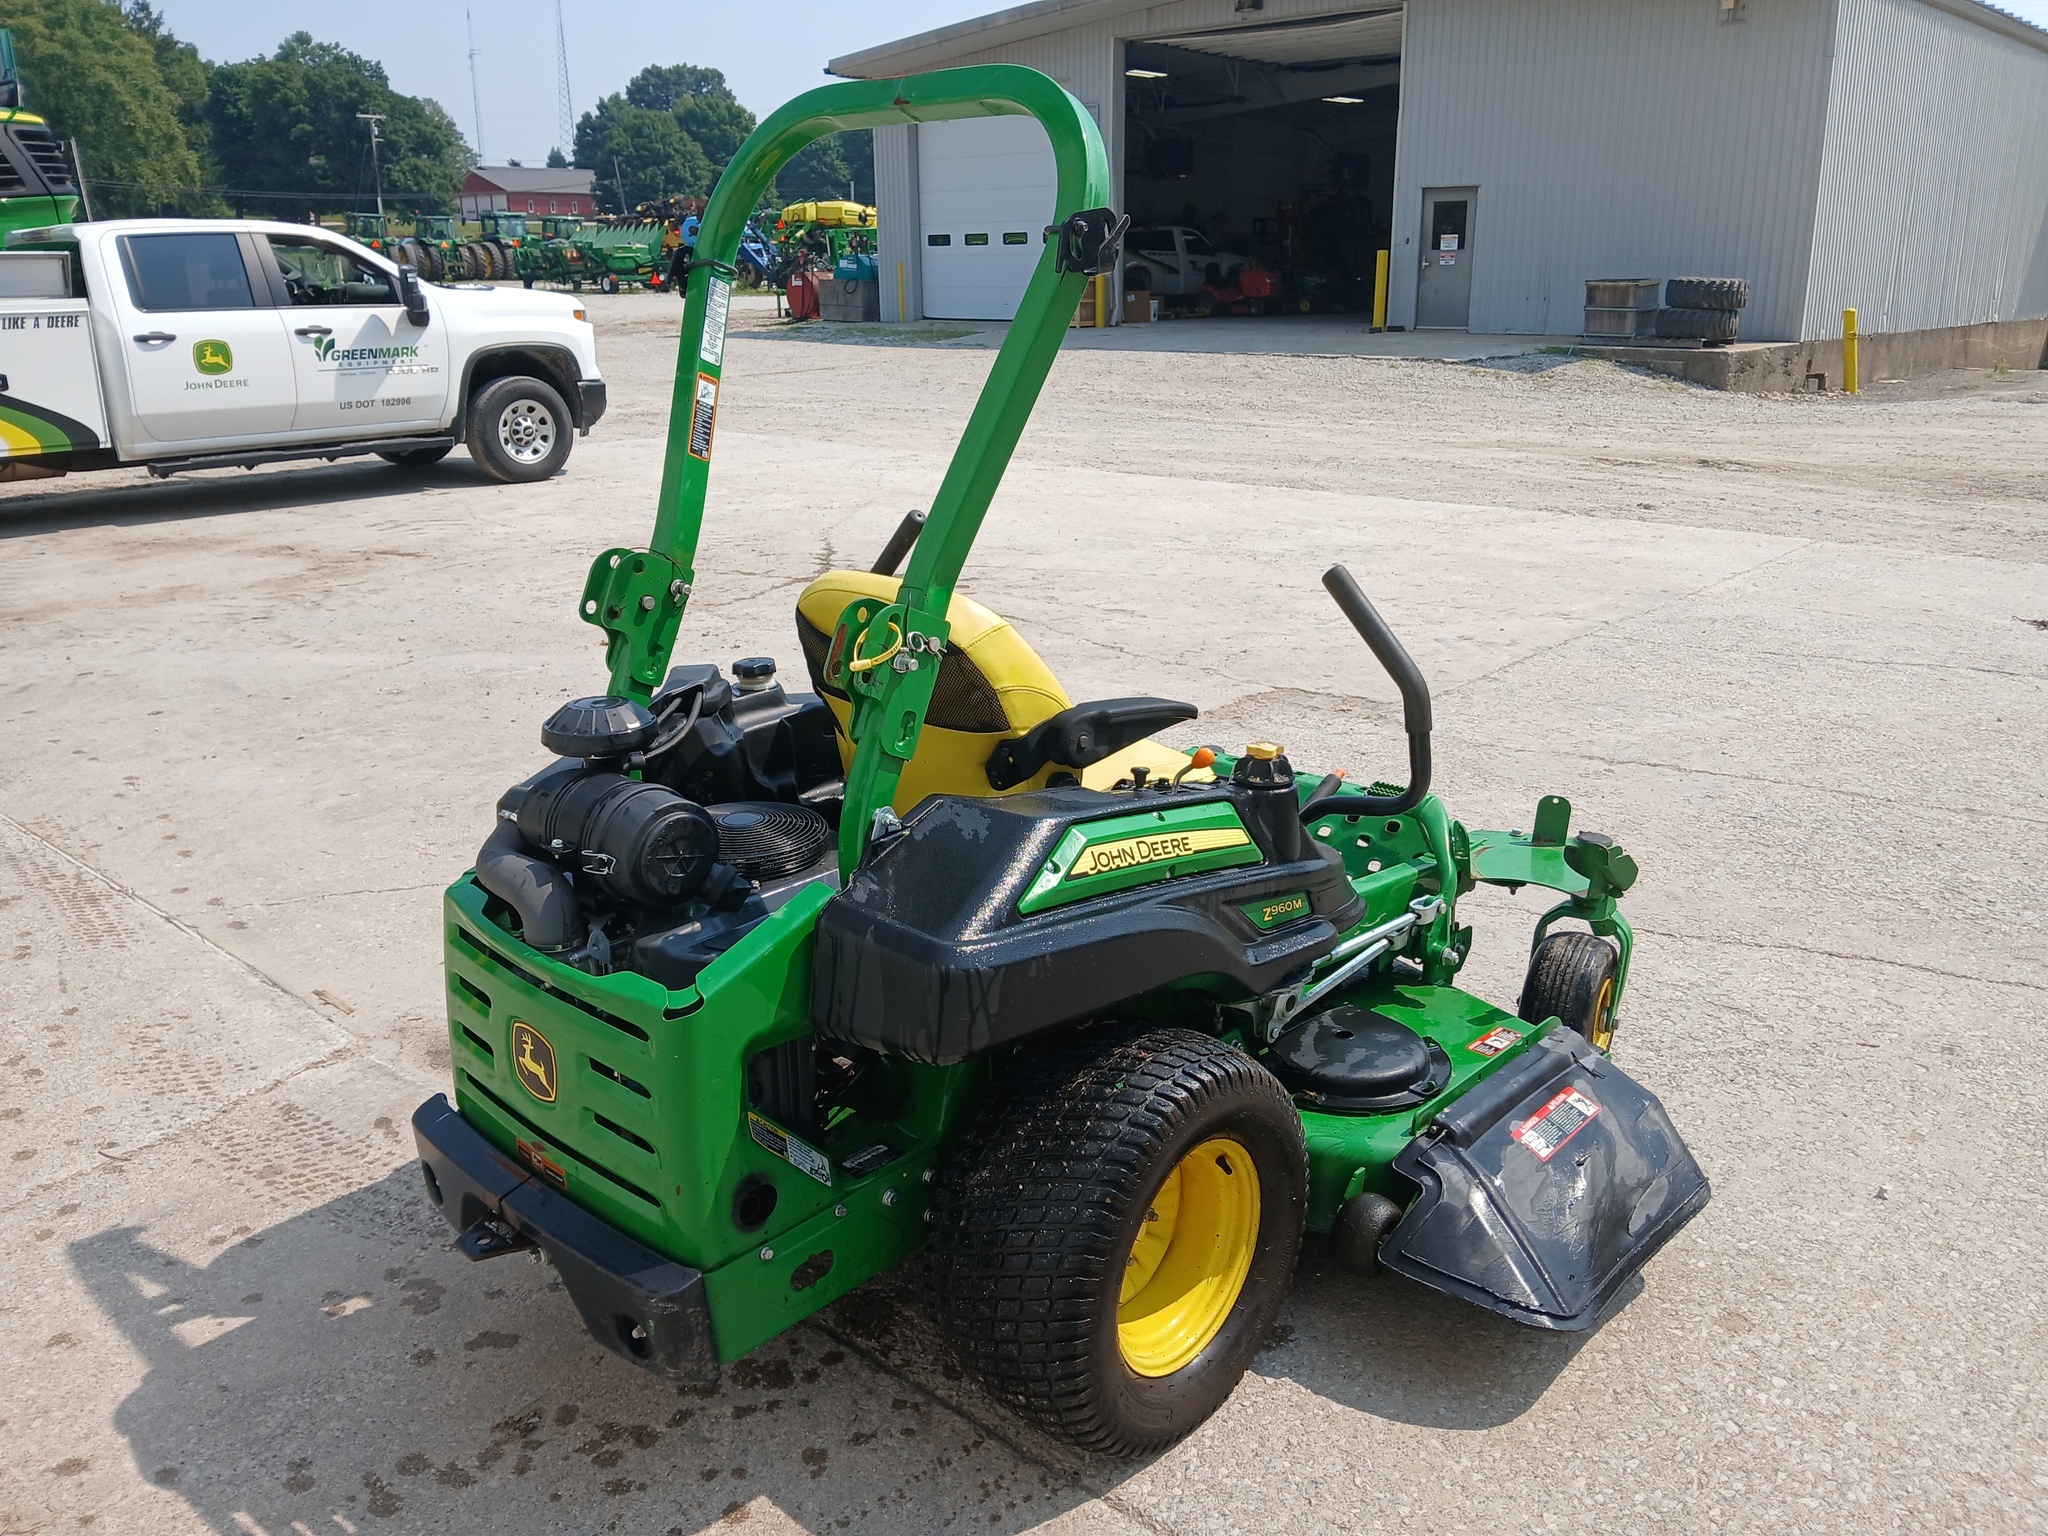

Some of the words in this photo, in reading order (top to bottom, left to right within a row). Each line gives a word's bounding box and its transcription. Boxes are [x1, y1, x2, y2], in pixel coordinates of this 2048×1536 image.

[2, 316, 26, 330] LIKE
[33, 316, 40, 329] A
[47, 315, 80, 328] DEERE
[331, 346, 419, 361] GREENMARK
[338, 359, 413, 368] EQUIPMENT
[184, 381, 213, 391] JOHN
[214, 379, 250, 389] DEERE
[340, 401, 353, 410] US
[355, 400, 376, 409] DOT
[381, 397, 412, 407] 182996
[1089, 844, 1136, 871] JOHN
[1136, 836, 1193, 860] DEERE
[1262, 898, 1303, 922] Z960M
